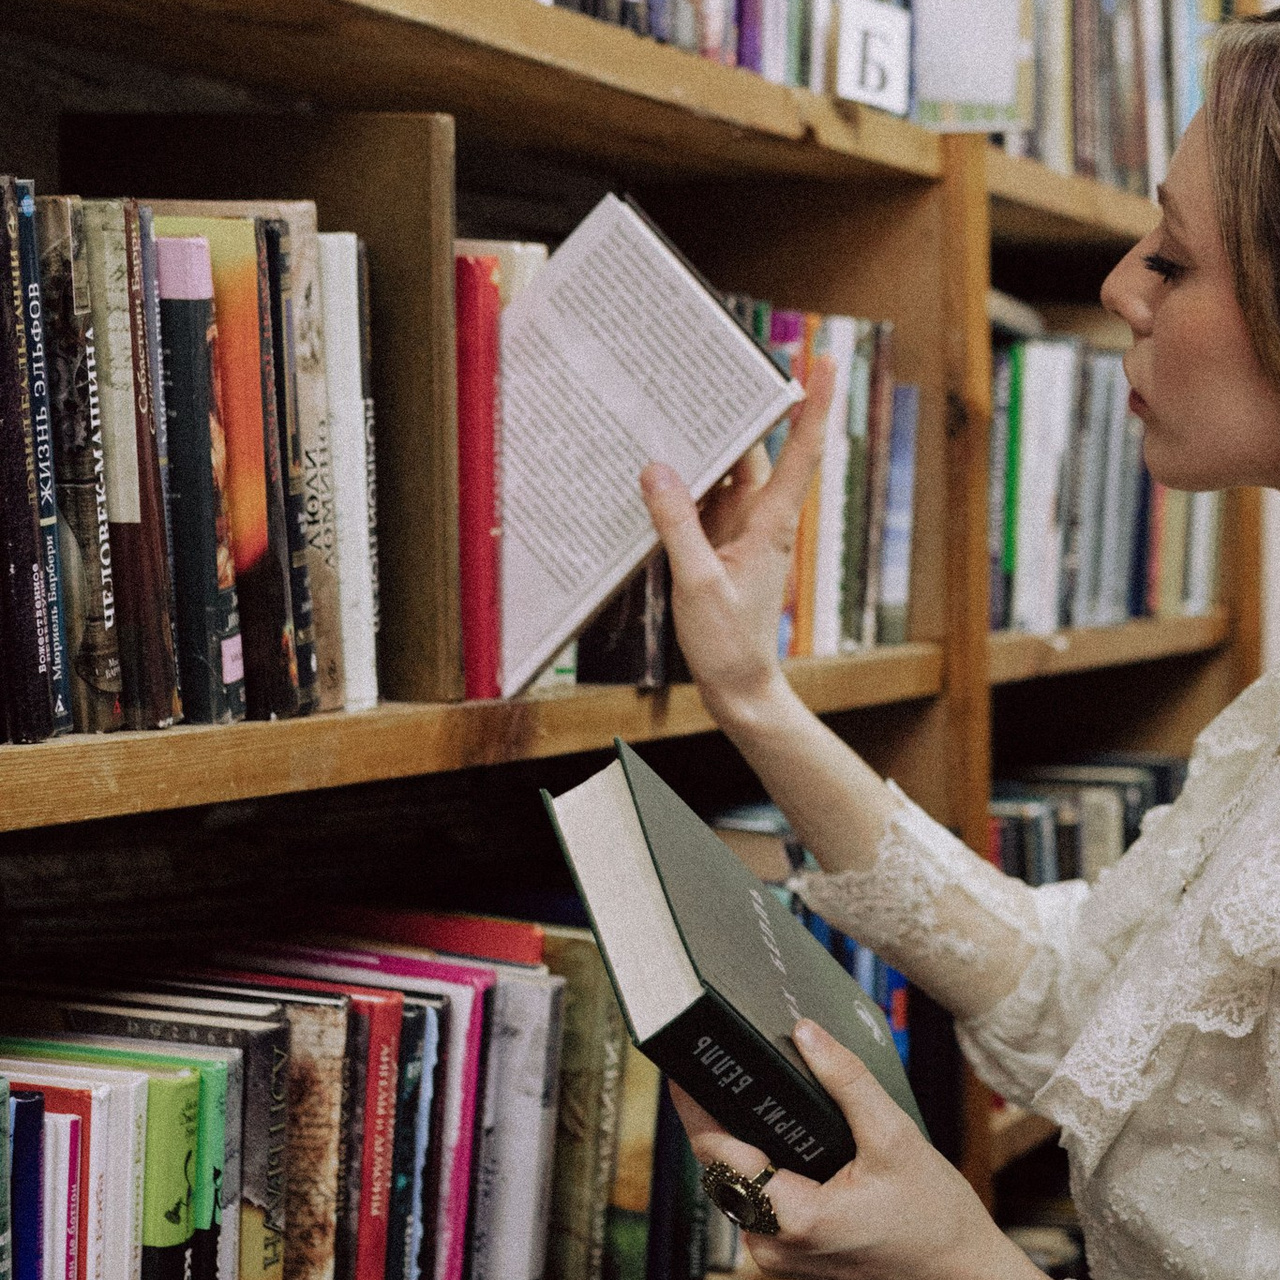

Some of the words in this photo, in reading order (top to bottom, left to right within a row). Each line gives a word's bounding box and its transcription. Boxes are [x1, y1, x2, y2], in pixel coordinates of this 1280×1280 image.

[858, 28, 889, 93] Б
[27, 281, 48, 398] ЭЛЬФОВ
[35, 405, 55, 506] ЖИЗНЬ
[44, 535, 59, 603] Барбери
[48, 605, 63, 682] Мюриель
[692, 1035, 754, 1095] БЁЛЛЬ
[752, 1096, 825, 1162] ГЕНРИХ
